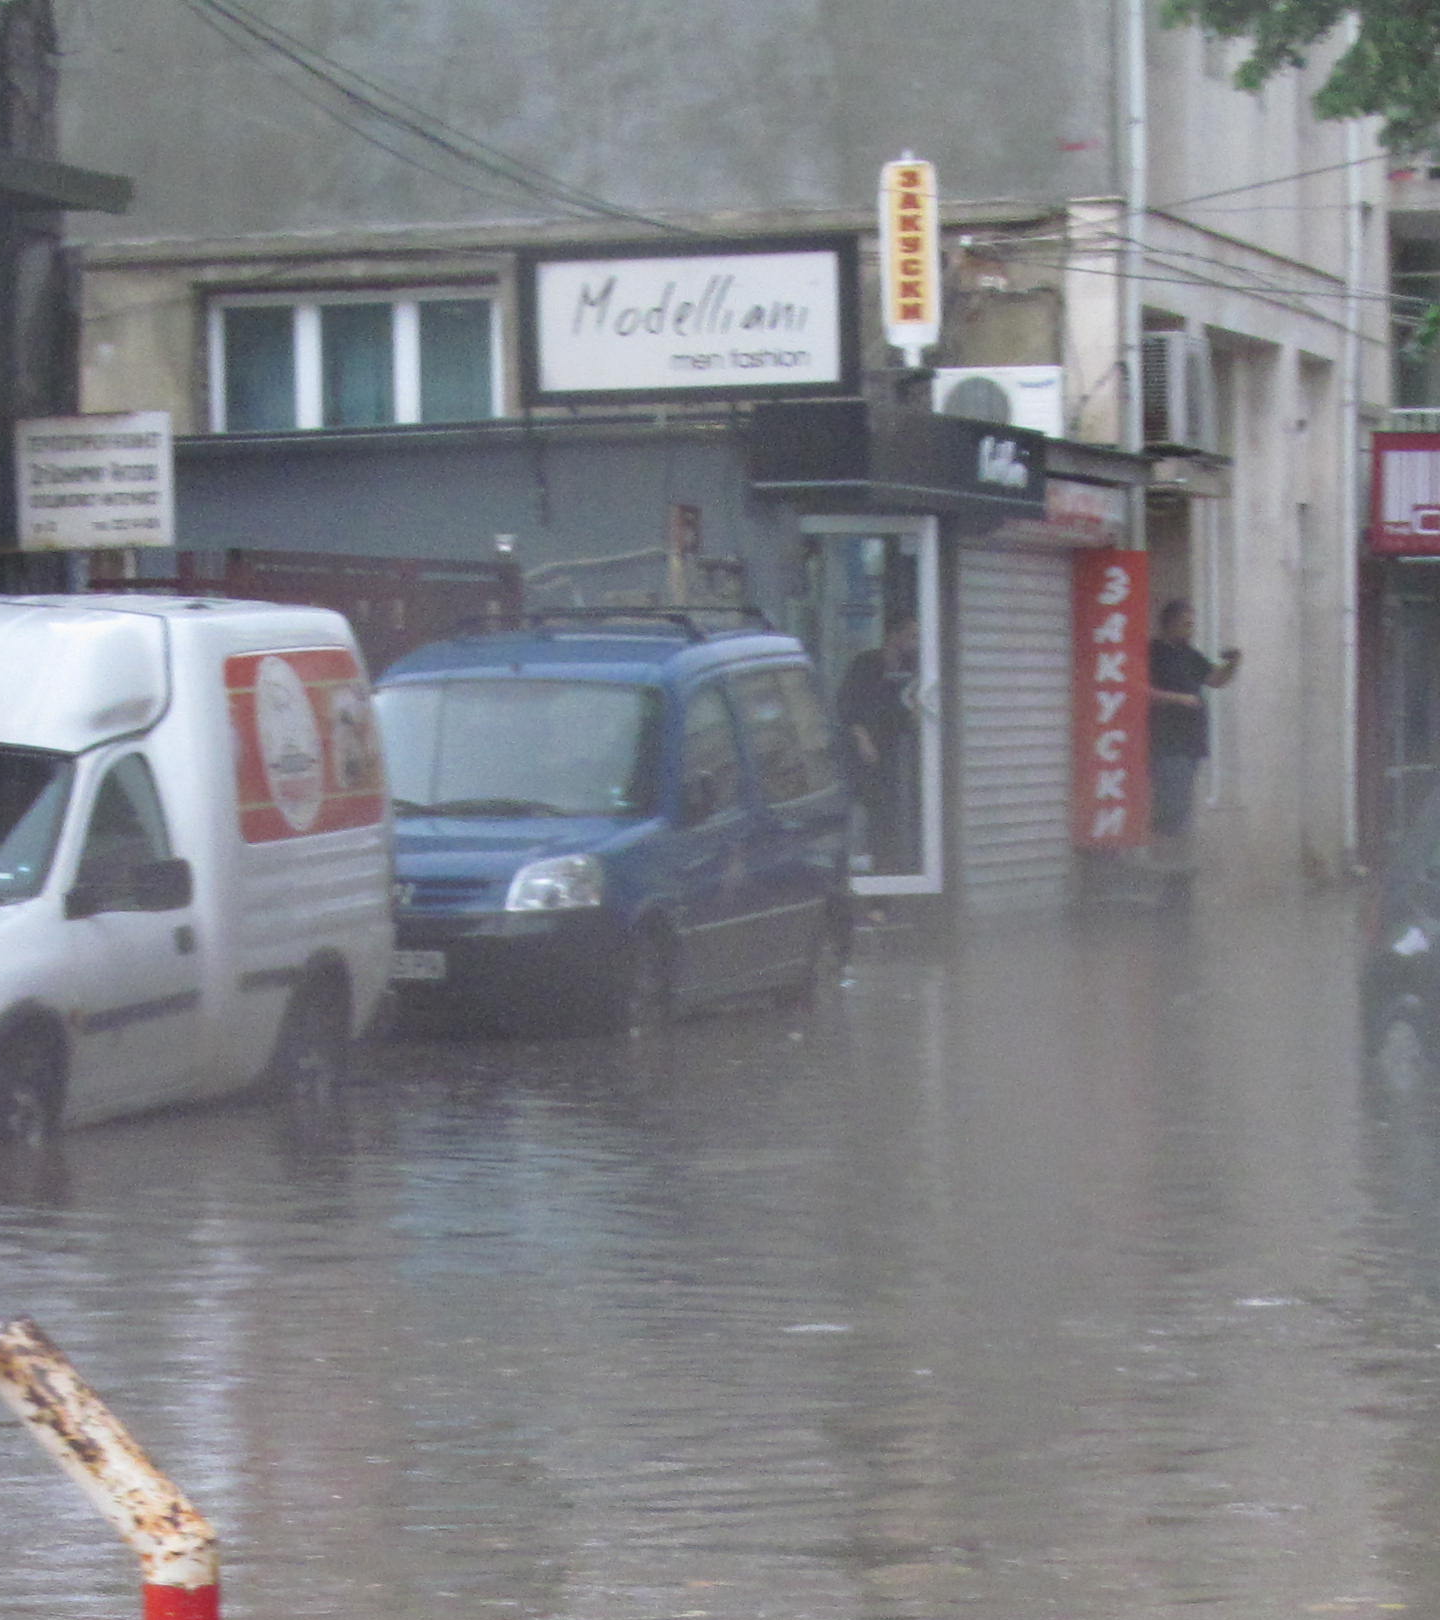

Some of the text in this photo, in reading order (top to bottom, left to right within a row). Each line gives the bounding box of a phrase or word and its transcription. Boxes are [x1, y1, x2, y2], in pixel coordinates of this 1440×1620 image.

[897, 169, 923, 321] ЗАКУСКИ
[572, 273, 810, 337] Modelliani
[671, 348, 810, 370] men fashion
[1090, 565, 1132, 839] ЗАКУСКИ
